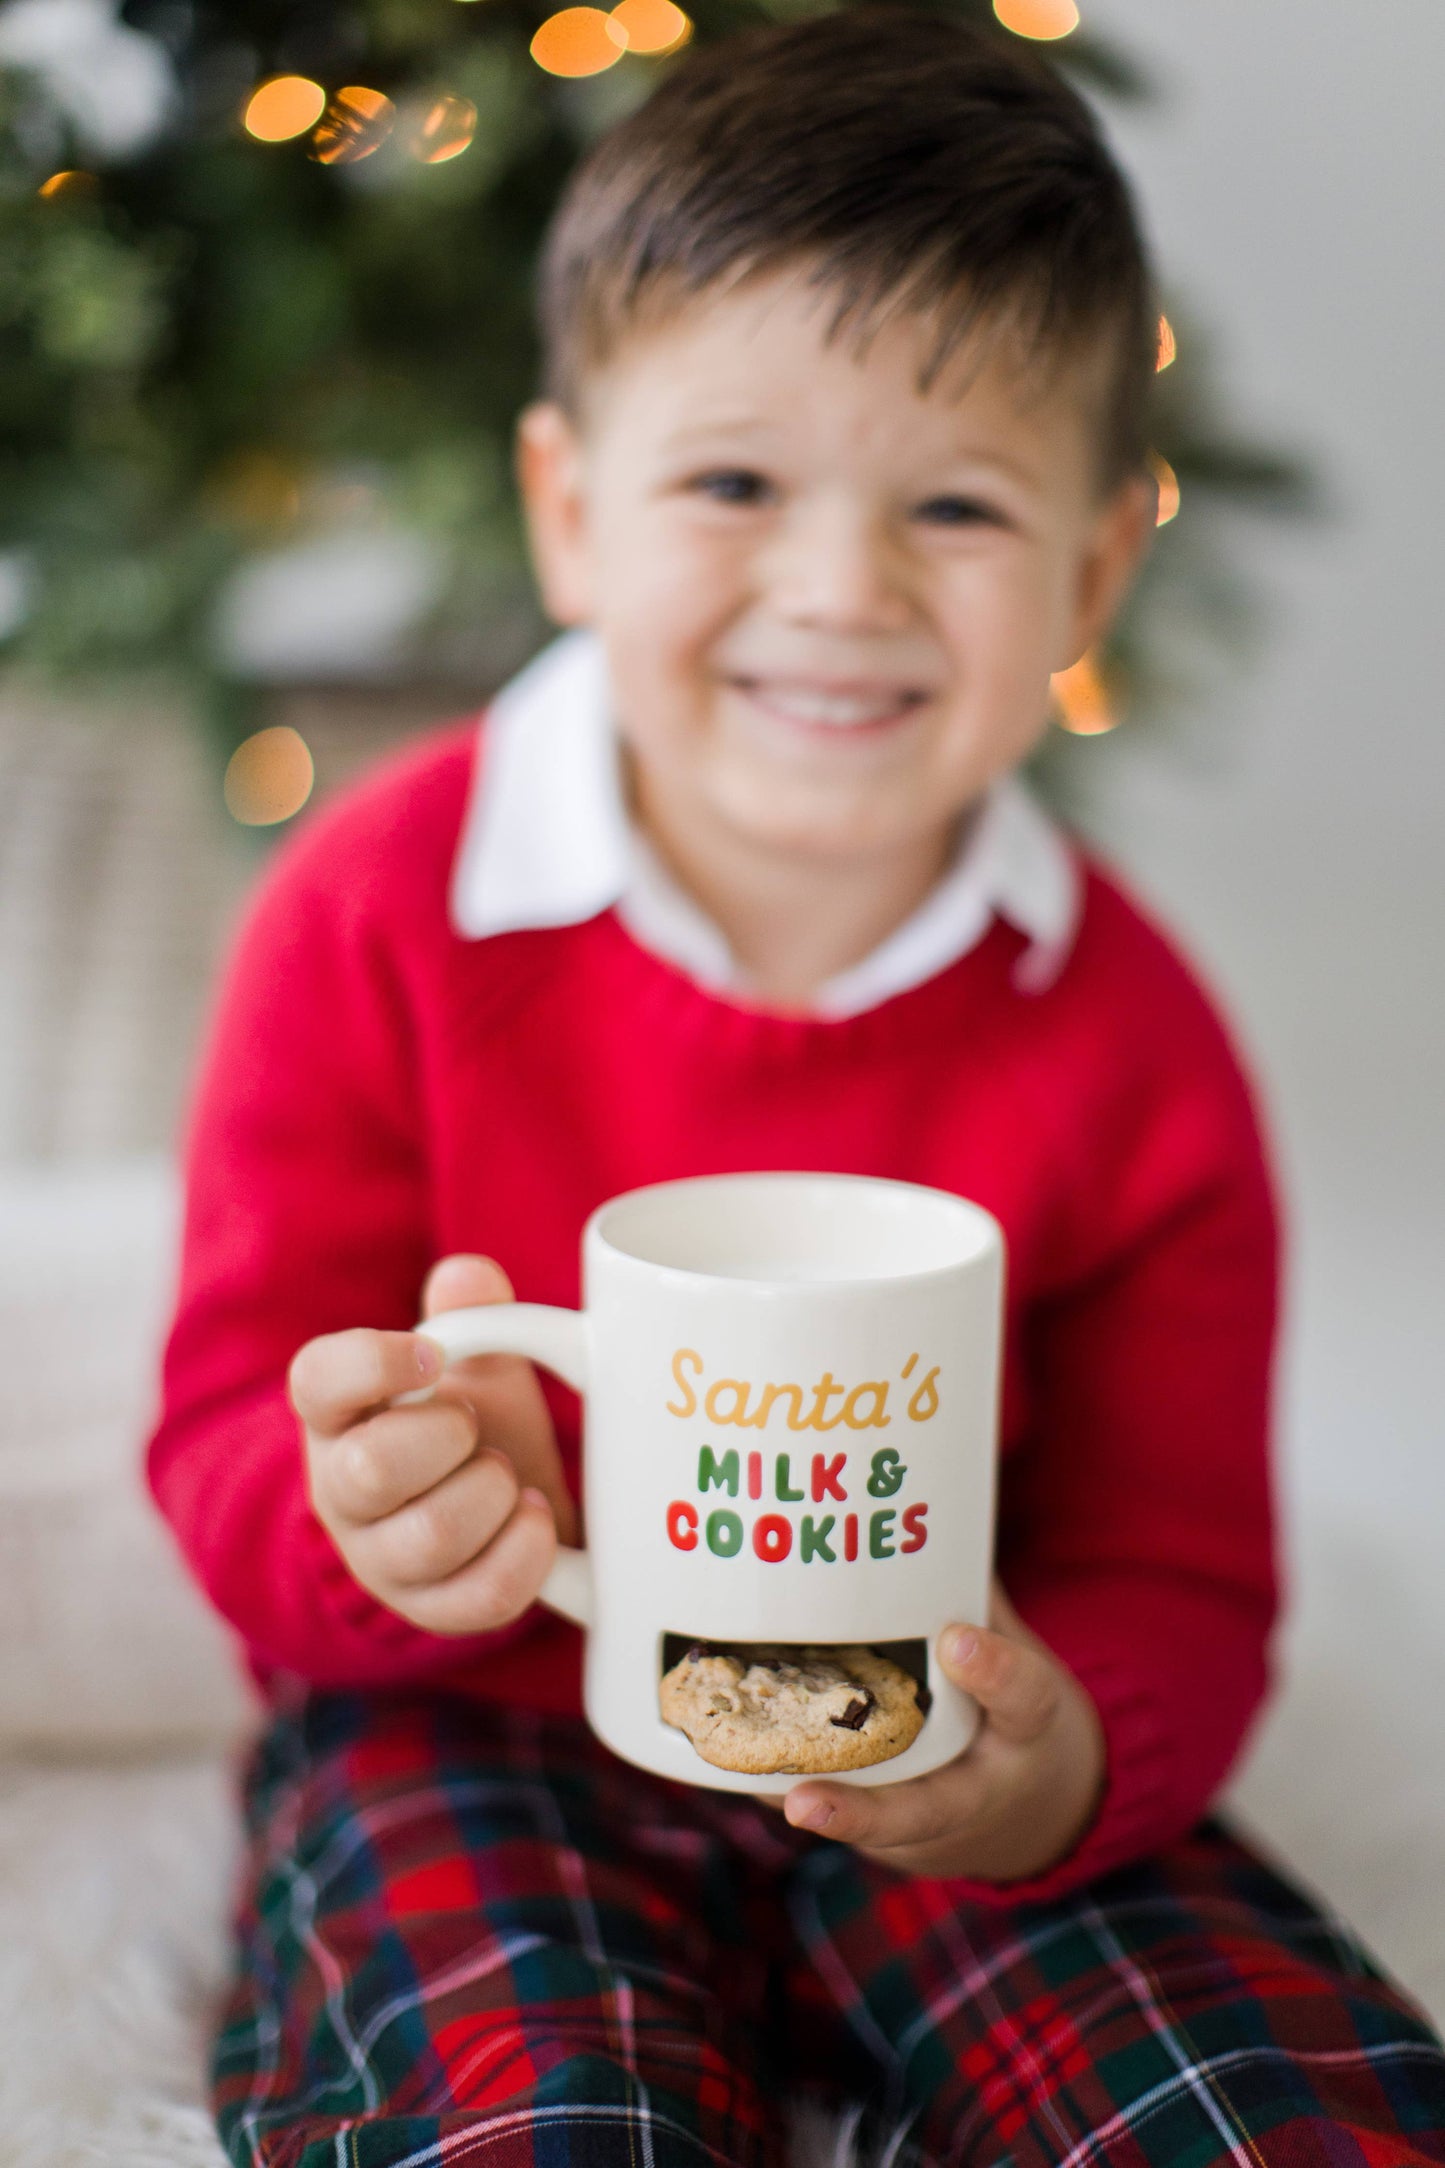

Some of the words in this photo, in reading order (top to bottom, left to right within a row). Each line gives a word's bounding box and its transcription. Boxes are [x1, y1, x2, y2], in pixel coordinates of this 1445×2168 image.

[666, 1348, 941, 1431] Santa's
[697, 1445, 848, 1503] MILK
[867, 1447, 907, 1498] &
[666, 1500, 929, 1563] COOKIES
